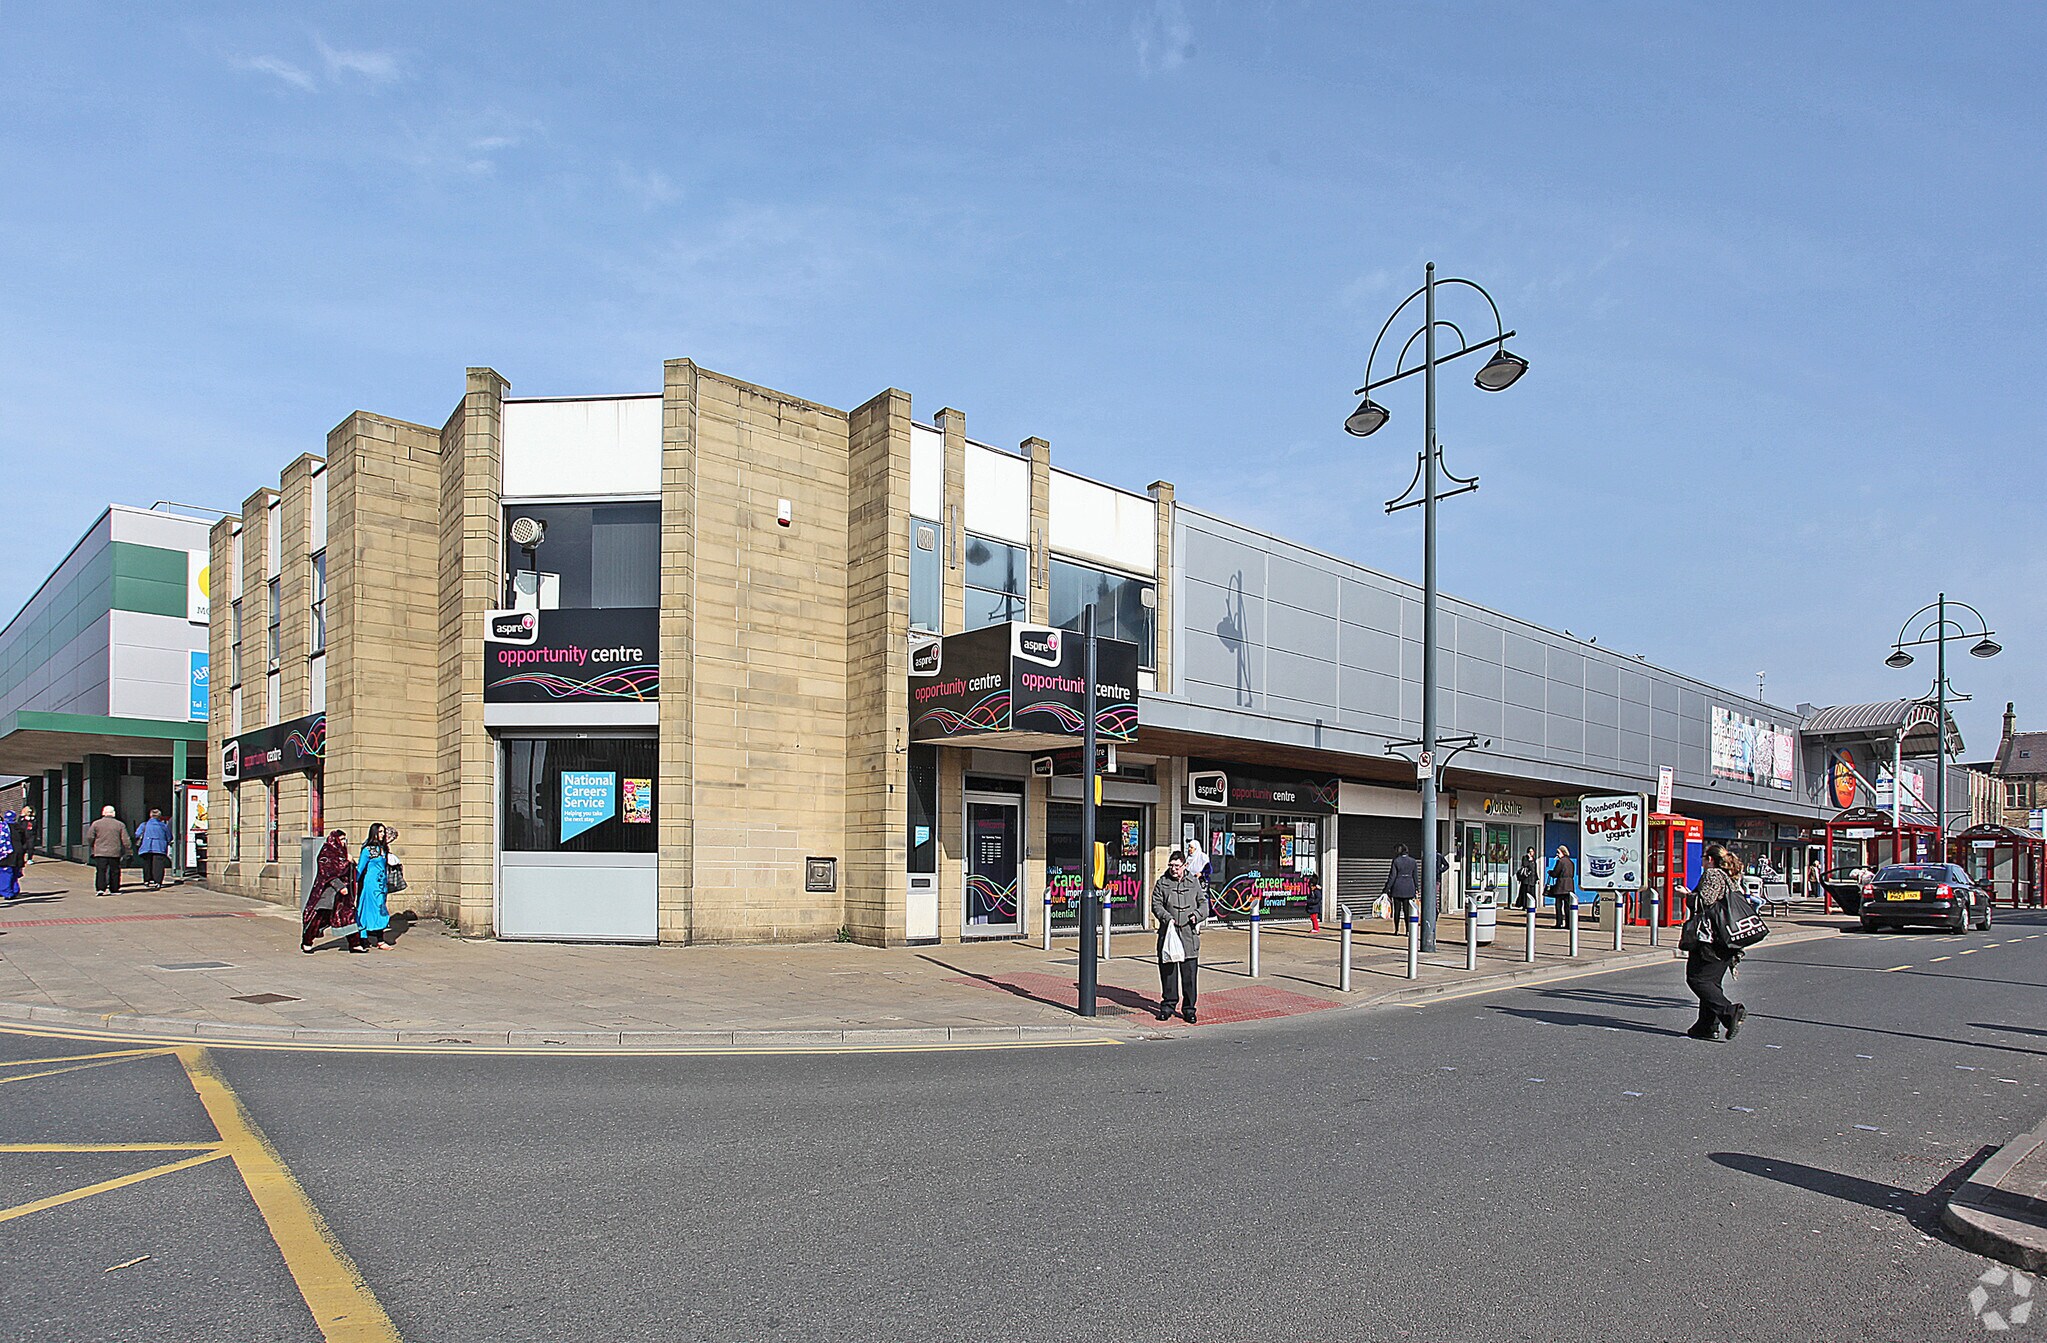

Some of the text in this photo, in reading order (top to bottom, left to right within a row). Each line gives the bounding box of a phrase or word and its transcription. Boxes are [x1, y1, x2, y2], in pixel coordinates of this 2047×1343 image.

[496, 624, 523, 635] aspire
[1024, 640, 1048, 653] aspire
[498, 644, 643, 667] opportunity centre
[915, 656, 932, 668] aspire
[915, 673, 1001, 703] opportunity centre
[1022, 672, 1131, 700] opportunit centre
[1713, 717, 1745, 742] Bradford
[1712, 737, 1743, 758] Markets
[267, 747, 282, 763] centre
[564, 774, 613, 786] National
[564, 785, 607, 796] Careers
[1198, 785, 1217, 796] aspire
[1231, 788, 1296, 802] opportunity centre
[564, 797, 605, 808] Service
[1606, 830, 1631, 842] yogurt
[1118, 860, 1137, 875] jobs
[1590, 858, 1616, 871] danio
[1054, 874, 1083, 887] care
[1255, 877, 1284, 889] career
[1264, 898, 1286, 907] forward
[1726, 915, 1763, 936] USC
